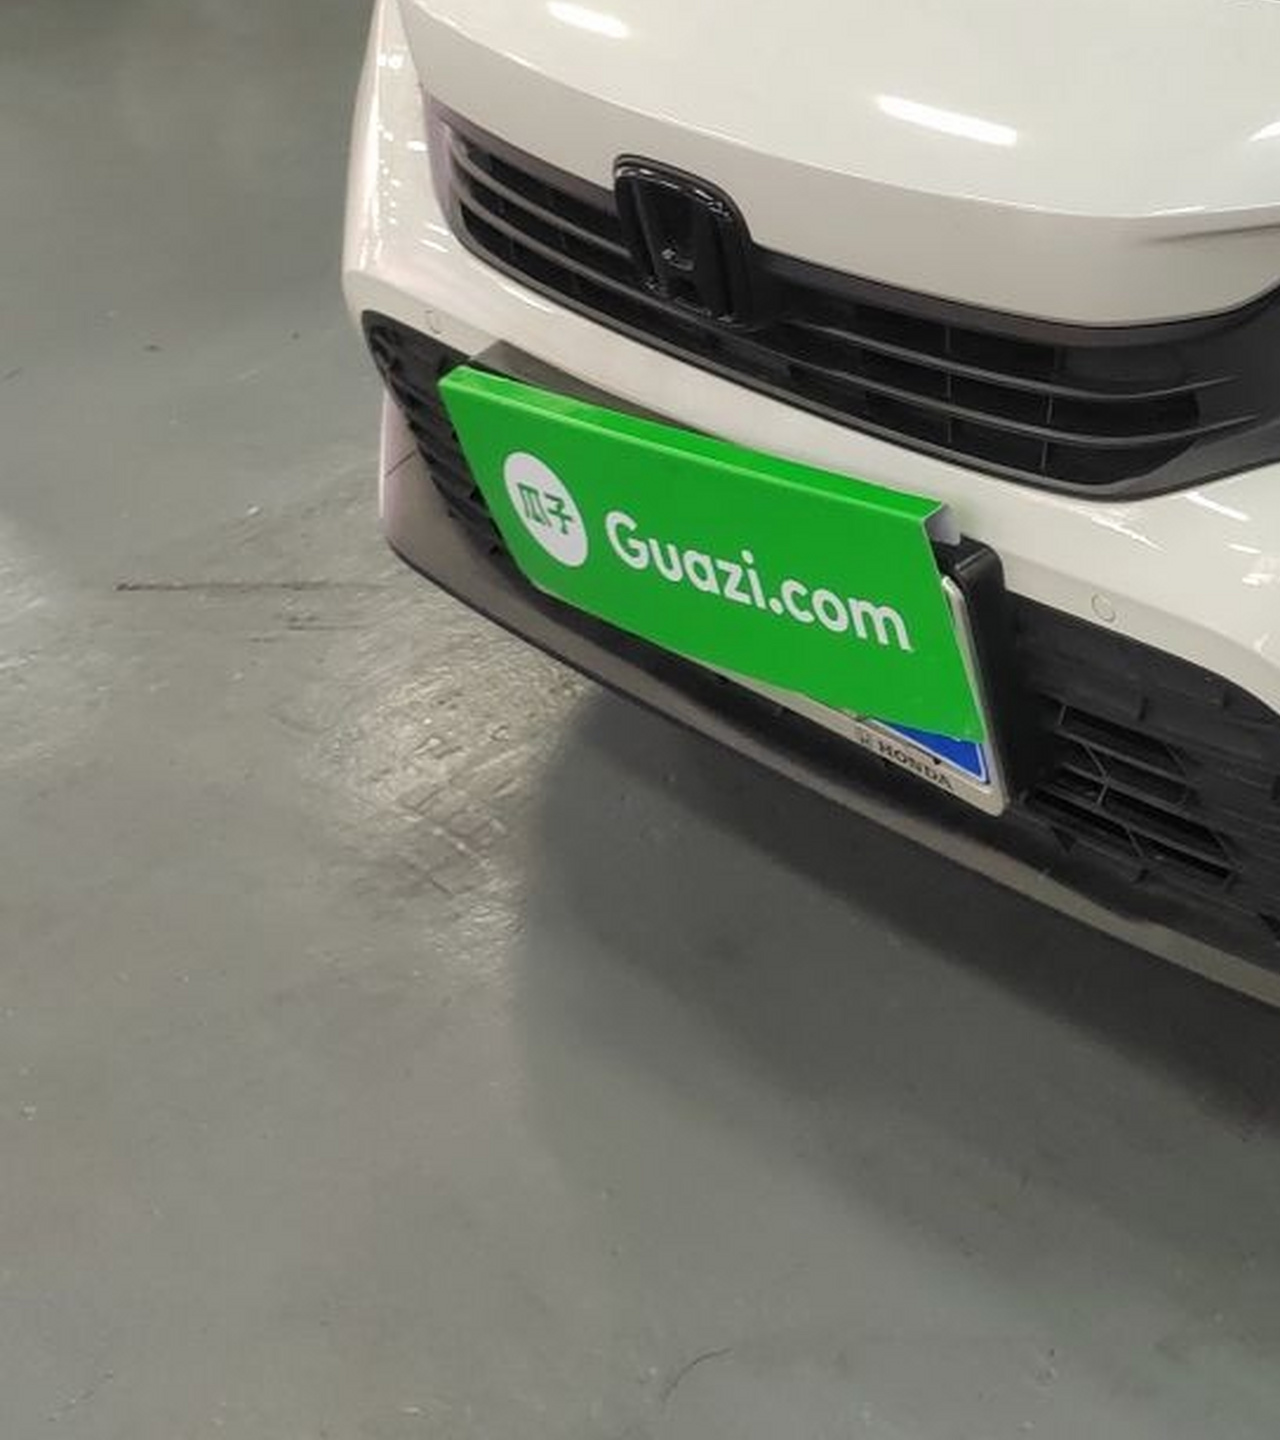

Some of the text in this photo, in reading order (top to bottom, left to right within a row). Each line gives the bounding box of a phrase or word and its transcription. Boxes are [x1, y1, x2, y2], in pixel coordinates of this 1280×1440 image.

[516, 482, 574, 536] 瓜子
[604, 510, 915, 653] Guazi.com
[877, 740, 954, 792] HONDA
